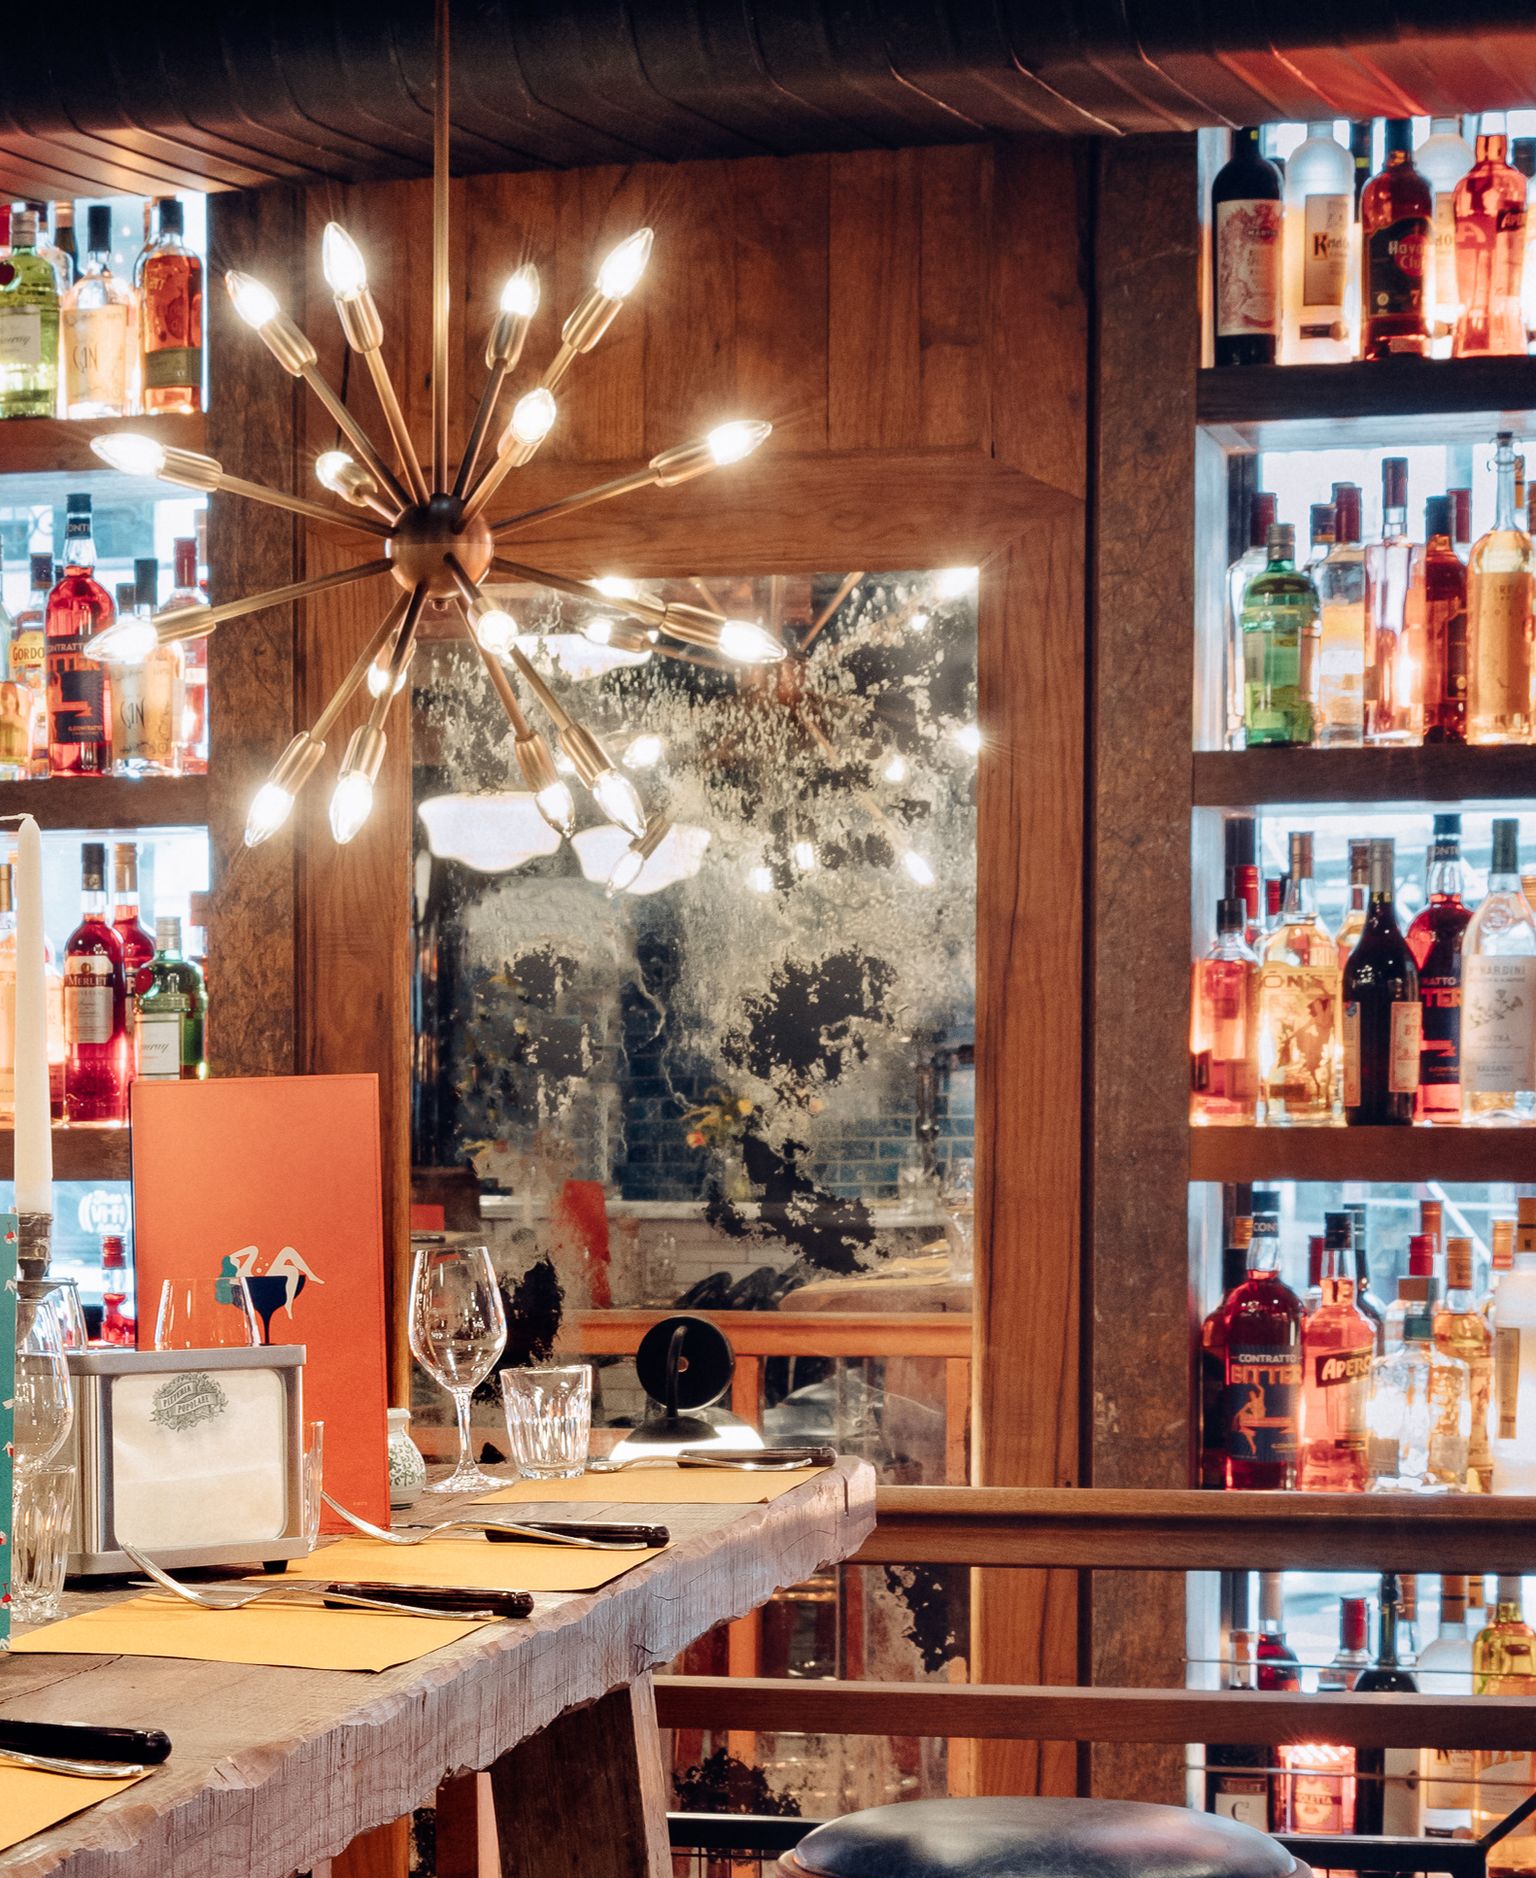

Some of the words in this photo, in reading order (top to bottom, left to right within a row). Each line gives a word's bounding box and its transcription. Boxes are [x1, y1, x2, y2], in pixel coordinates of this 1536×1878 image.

[67, 975, 109, 988] MERLET
[1238, 1353, 1298, 1364] CONTRATTO
[1230, 1365, 1303, 1384] BITTER
[1321, 1355, 1373, 1382] APERO
